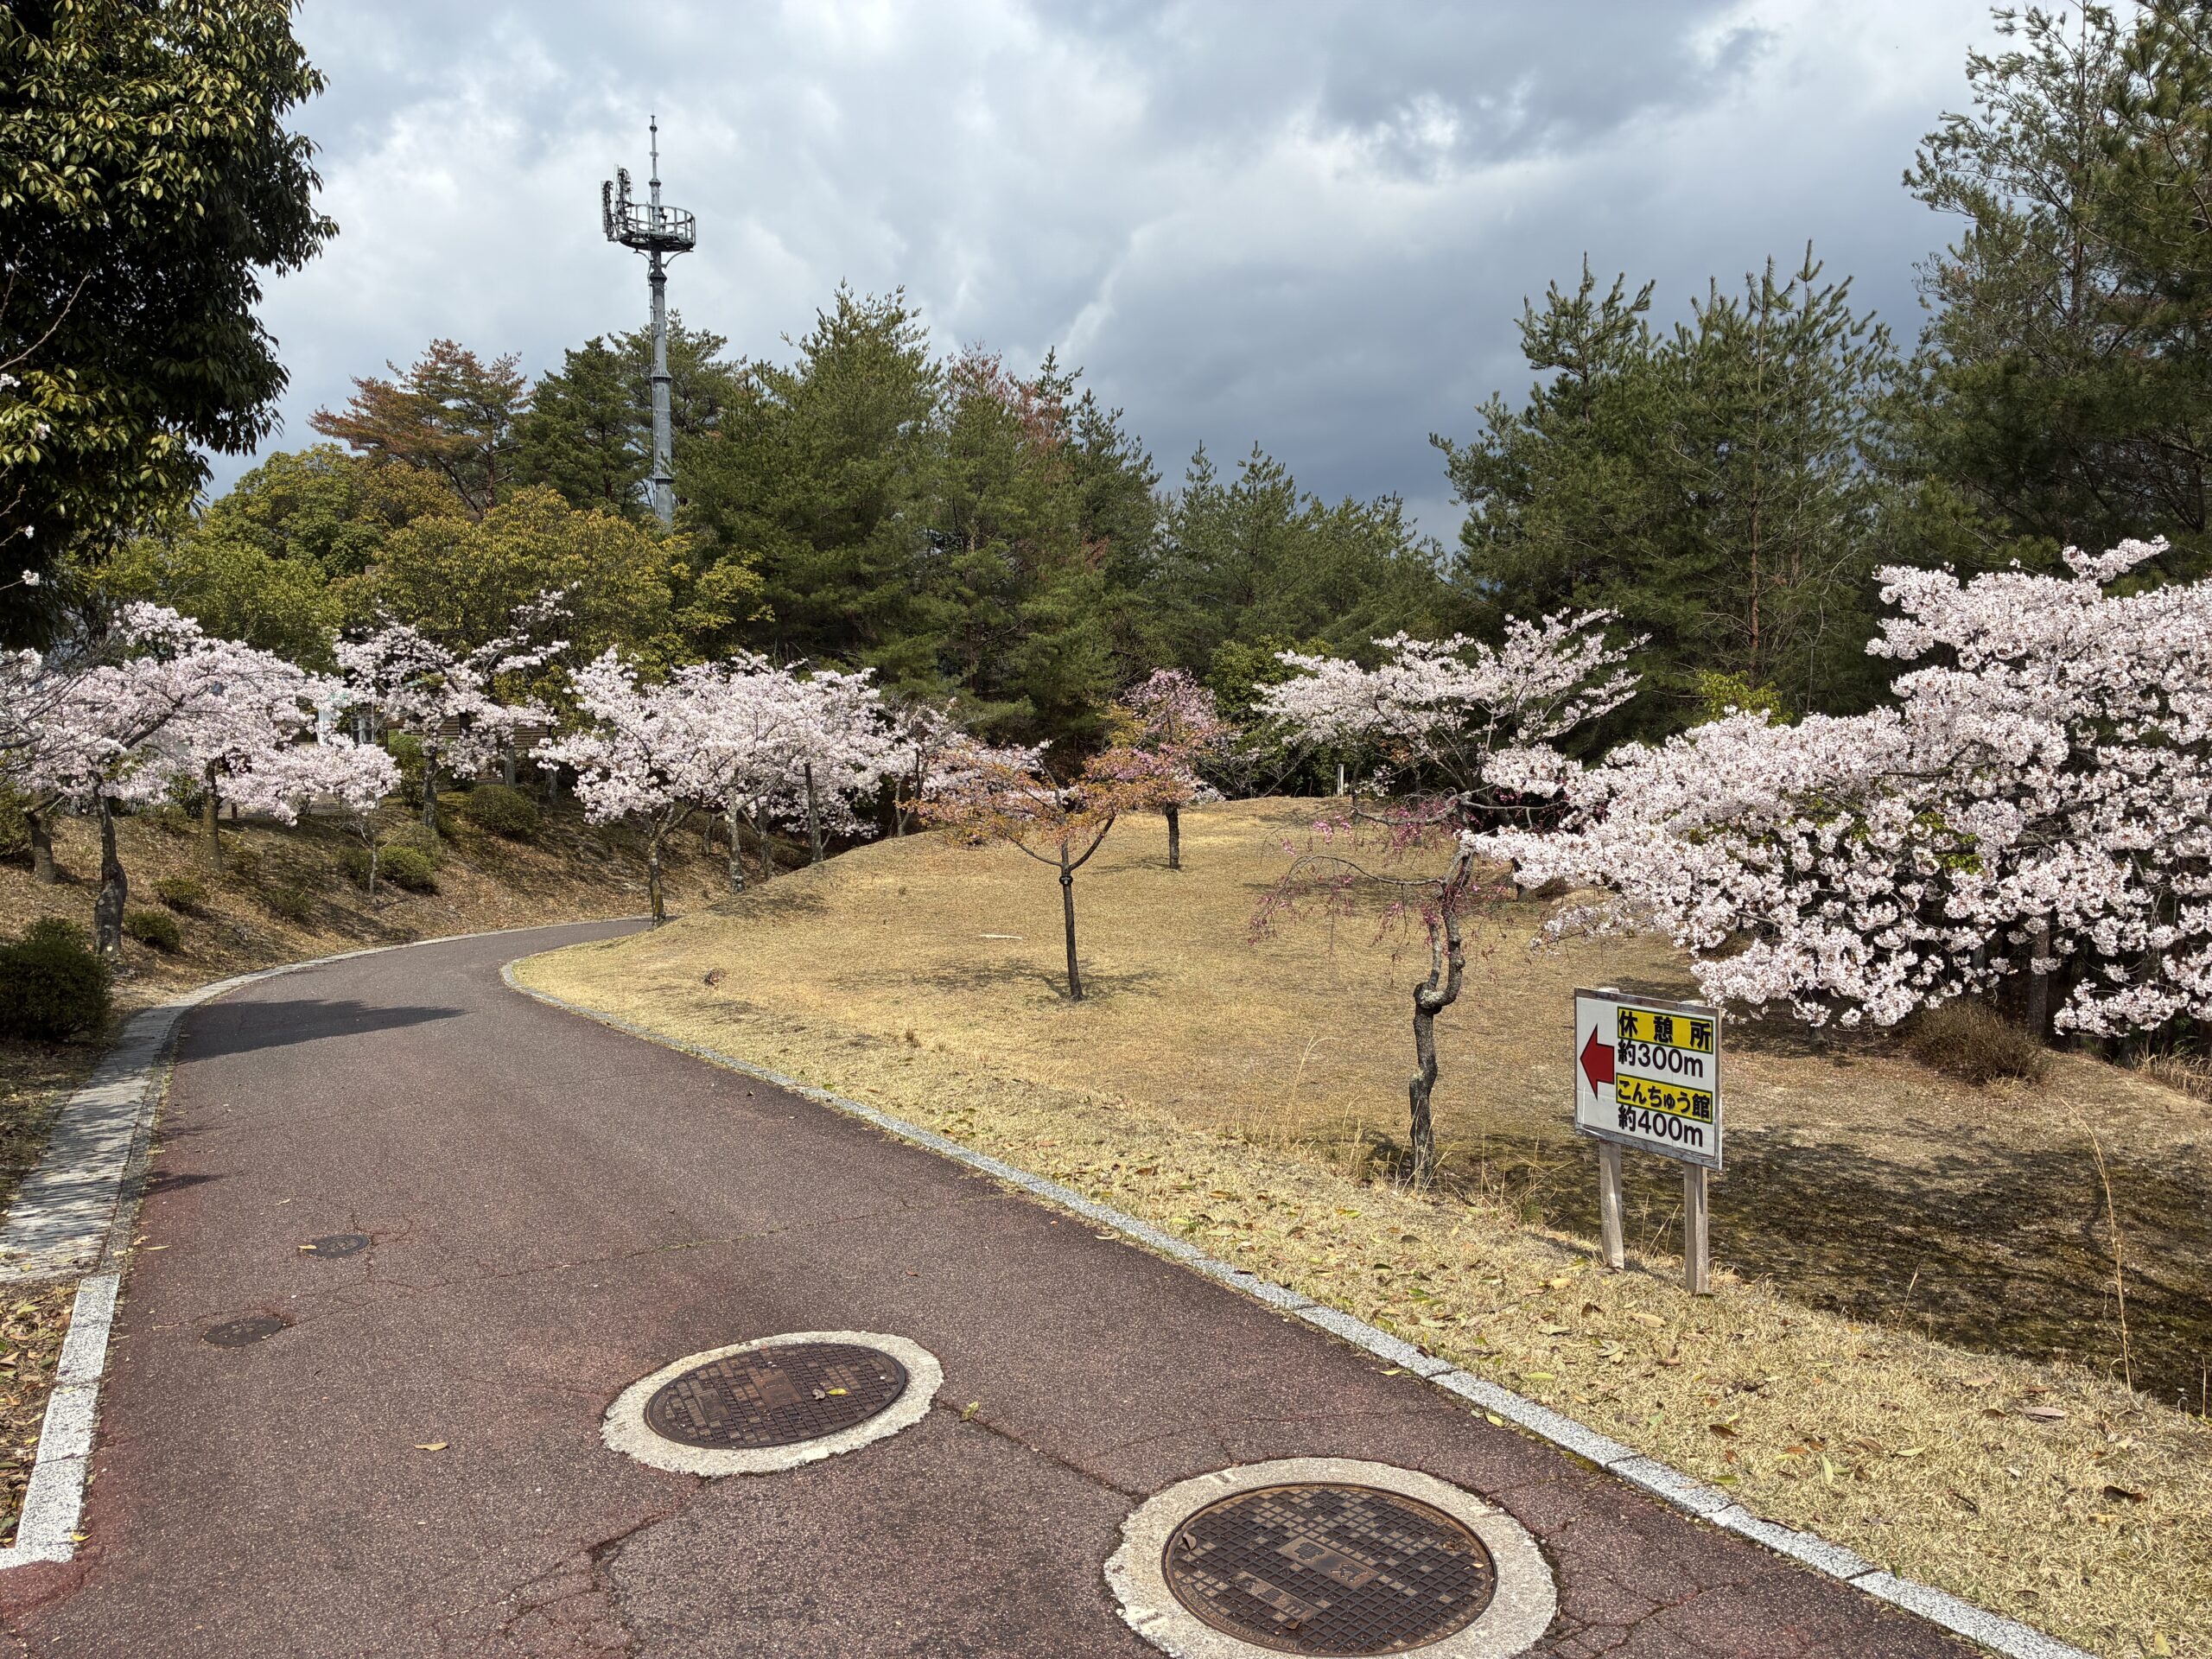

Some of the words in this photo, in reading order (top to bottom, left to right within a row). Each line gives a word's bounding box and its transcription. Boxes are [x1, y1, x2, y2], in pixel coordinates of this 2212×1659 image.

[1618, 1010, 1712, 1051] 休憩所
[1618, 1039, 1704, 1078] 約300m
[1617, 1079, 1711, 1120] こんちゅう館
[1618, 1104, 1704, 1147] 約400m
